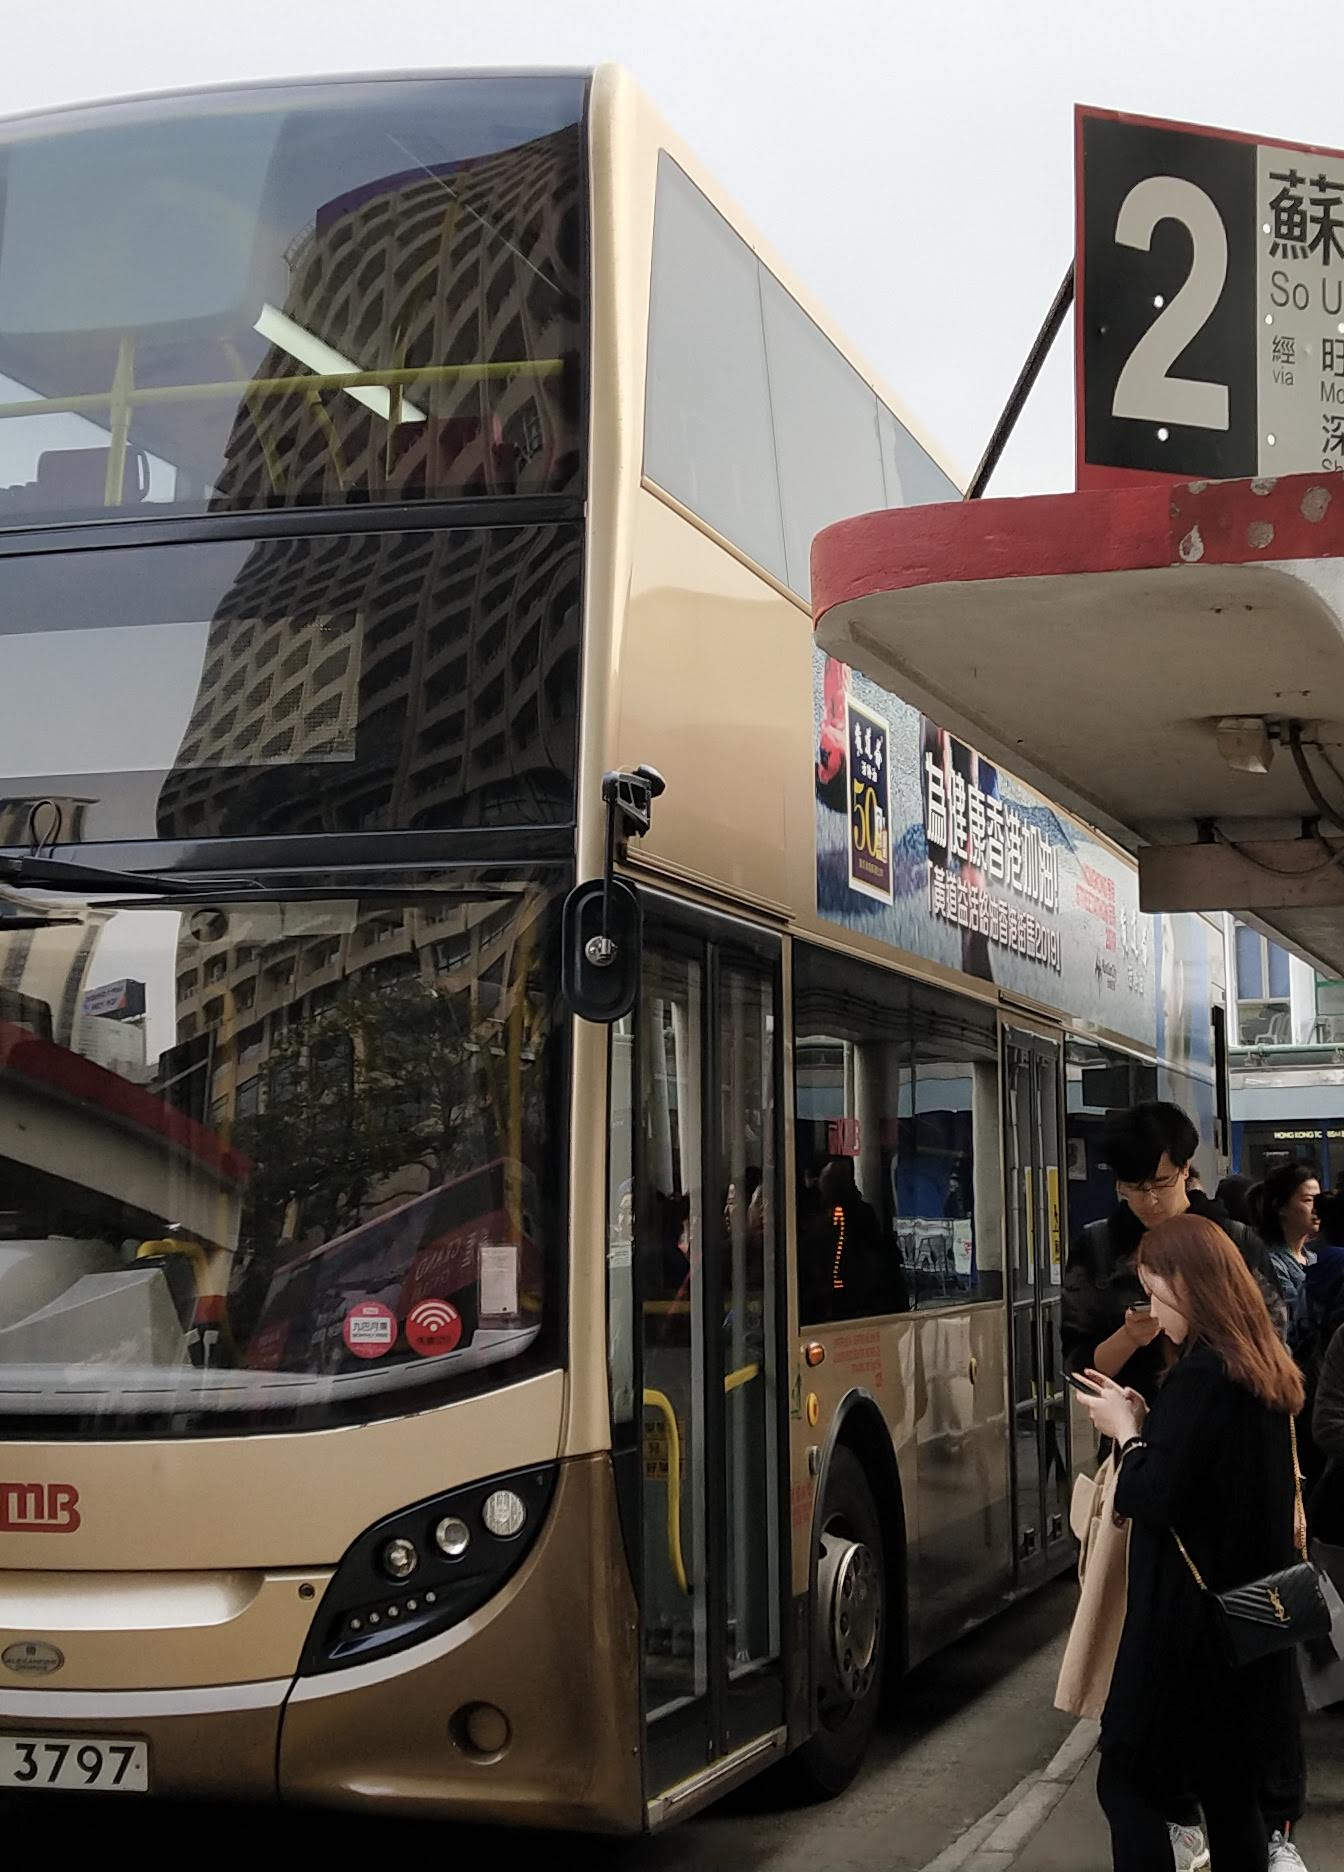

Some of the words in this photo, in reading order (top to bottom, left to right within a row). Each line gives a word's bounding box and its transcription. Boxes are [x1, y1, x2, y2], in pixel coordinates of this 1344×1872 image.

[1112, 175, 1230, 431] 2
[1270, 270, 1310, 310] So
[1272, 367, 1295, 386] via
[13, 1743, 136, 1785] 3797
